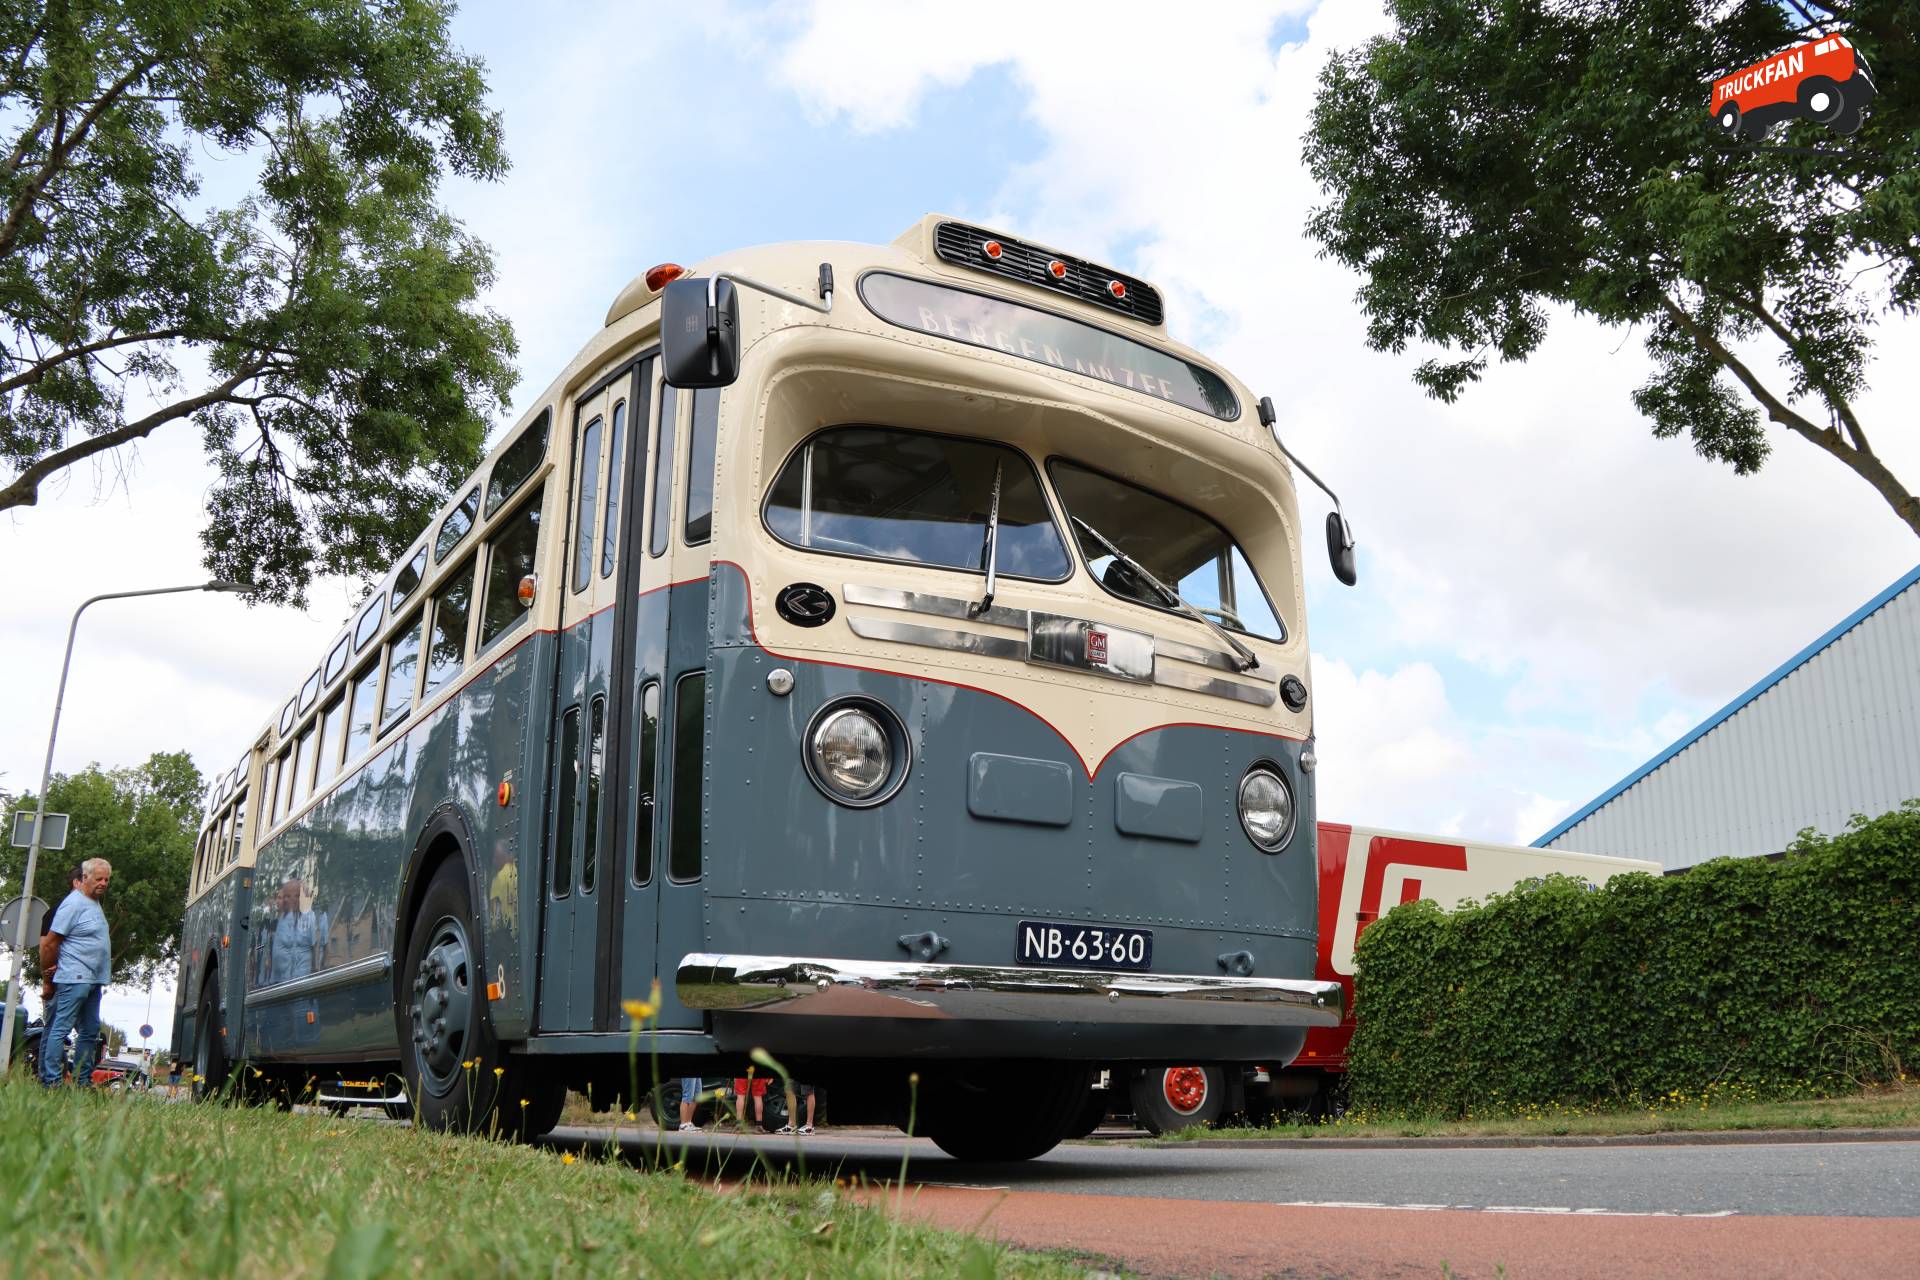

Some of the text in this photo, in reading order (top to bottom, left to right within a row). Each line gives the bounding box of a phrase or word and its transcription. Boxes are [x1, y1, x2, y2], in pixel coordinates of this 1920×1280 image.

[918, 306, 1064, 368] BERGEN
[1090, 635, 1105, 648] GM
[497, 963, 506, 1000] 8
